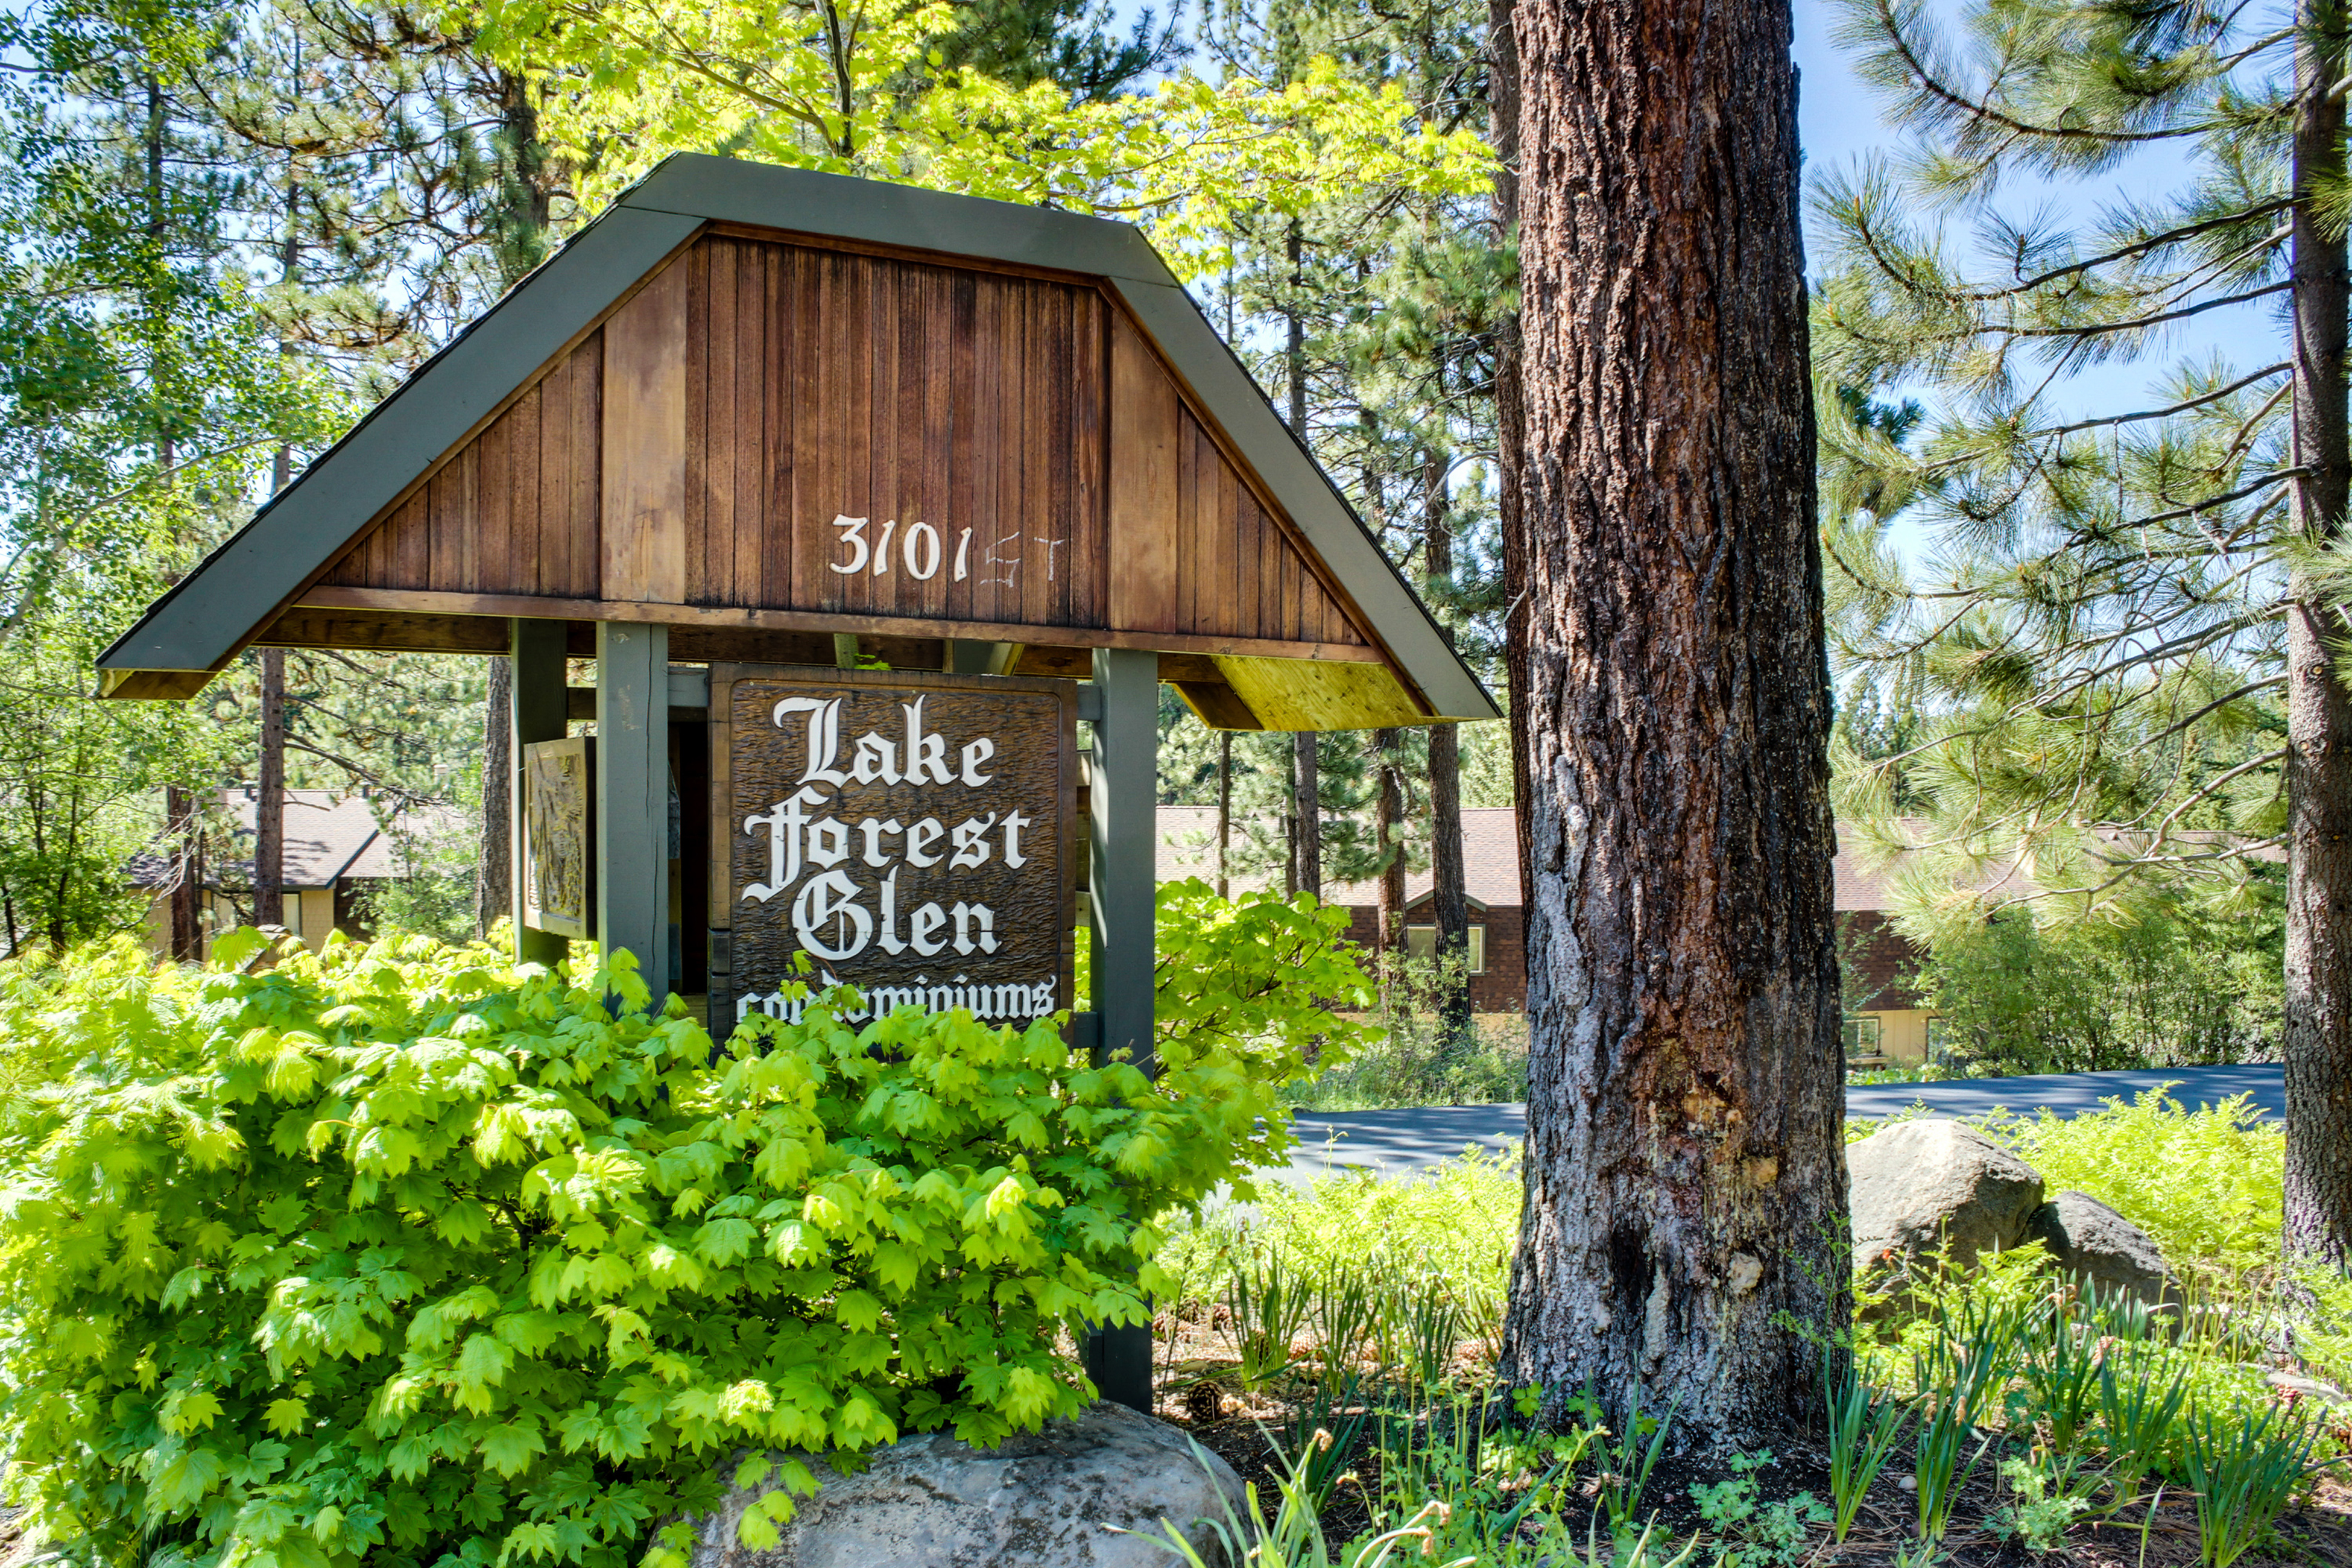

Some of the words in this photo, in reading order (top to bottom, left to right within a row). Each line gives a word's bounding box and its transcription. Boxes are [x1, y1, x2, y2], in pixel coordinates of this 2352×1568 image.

[829, 514, 973, 583] 3101
[773, 694, 994, 788] Lake
[741, 786, 1031, 903] Forest
[792, 865, 1002, 961] Glen
